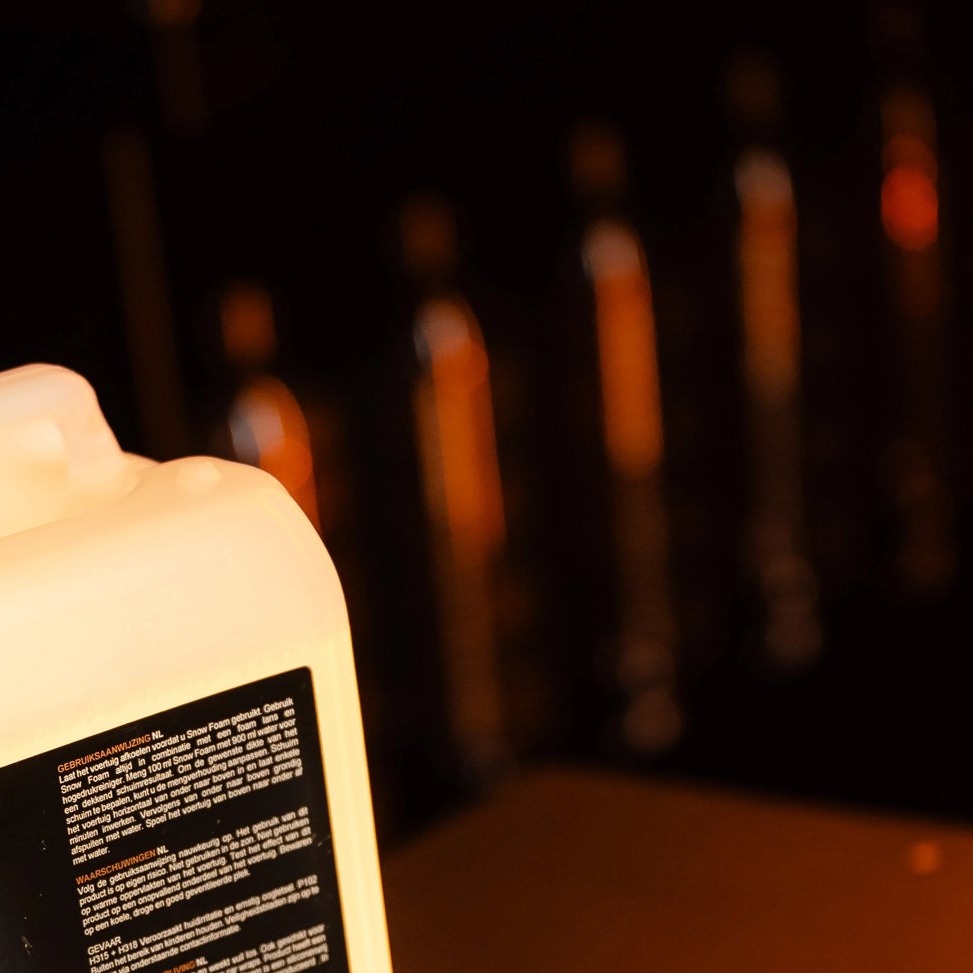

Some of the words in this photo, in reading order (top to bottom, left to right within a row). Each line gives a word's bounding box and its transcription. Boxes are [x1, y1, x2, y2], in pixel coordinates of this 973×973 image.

[57, 734, 151, 773] GEBRUIKSAANWIJZING
[152, 730, 164, 740] NL
[59, 771, 76, 784] Laat
[76, 767, 89, 778] het
[90, 757, 120, 776] voertuig
[120, 746, 151, 762] afkoelen
[151, 735, 179, 751] voordat
[186, 726, 208, 739] Snow
[208, 719, 230, 731] Foam
[61, 781, 82, 794] Snow
[87, 771, 109, 784] Foam
[115, 762, 132, 774] altijd
[138, 758, 146, 766] in
[151, 742, 191, 761] combinatie
[196, 734, 211, 746] met
[217, 729, 231, 739] een
[64, 804, 78, 814] een
[82, 790, 113, 808] dekkend
[177, 764, 192, 774] Om
[194, 759, 204, 768] de
[208, 746, 243, 765] gewenste
[125, 769, 147, 783] Meng
[148, 762, 162, 773] 100
[162, 758, 172, 768] ml
[172, 752, 194, 765] Snow
[194, 745, 216, 757] Foam
[216, 738, 231, 750] met
[231, 733, 246, 745] 900
[66, 810, 92, 824] schuim
[93, 807, 100, 815] te
[133, 788, 150, 800] kunt
[156, 783, 166, 792] de
[167, 762, 227, 788] mengverhouding
[67, 824, 80, 835] het
[81, 814, 111, 832] voertuig
[113, 798, 152, 818] horizontaal
[154, 793, 168, 803] van
[170, 785, 192, 797] onder
[193, 778, 210, 789] naar
[212, 770, 235, 783] boven
[237, 766, 245, 775] in
[69, 829, 98, 845] minuten
[140, 799, 181, 821] Vervolgens
[184, 793, 198, 803] van
[201, 784, 223, 797] onder
[226, 777, 243, 789] naar
[71, 838, 104, 855] afspuiten
[106, 831, 120, 842] met
[145, 813, 167, 828] Spoel
[168, 809, 181, 820] het
[182, 799, 211, 814] voertuig
[212, 794, 227, 804] van
[227, 785, 251, 799] boven
[73, 854, 87, 865] met
[76, 849, 156, 885] WAARSCHUWINGEN
[156, 845, 169, 855] NL
